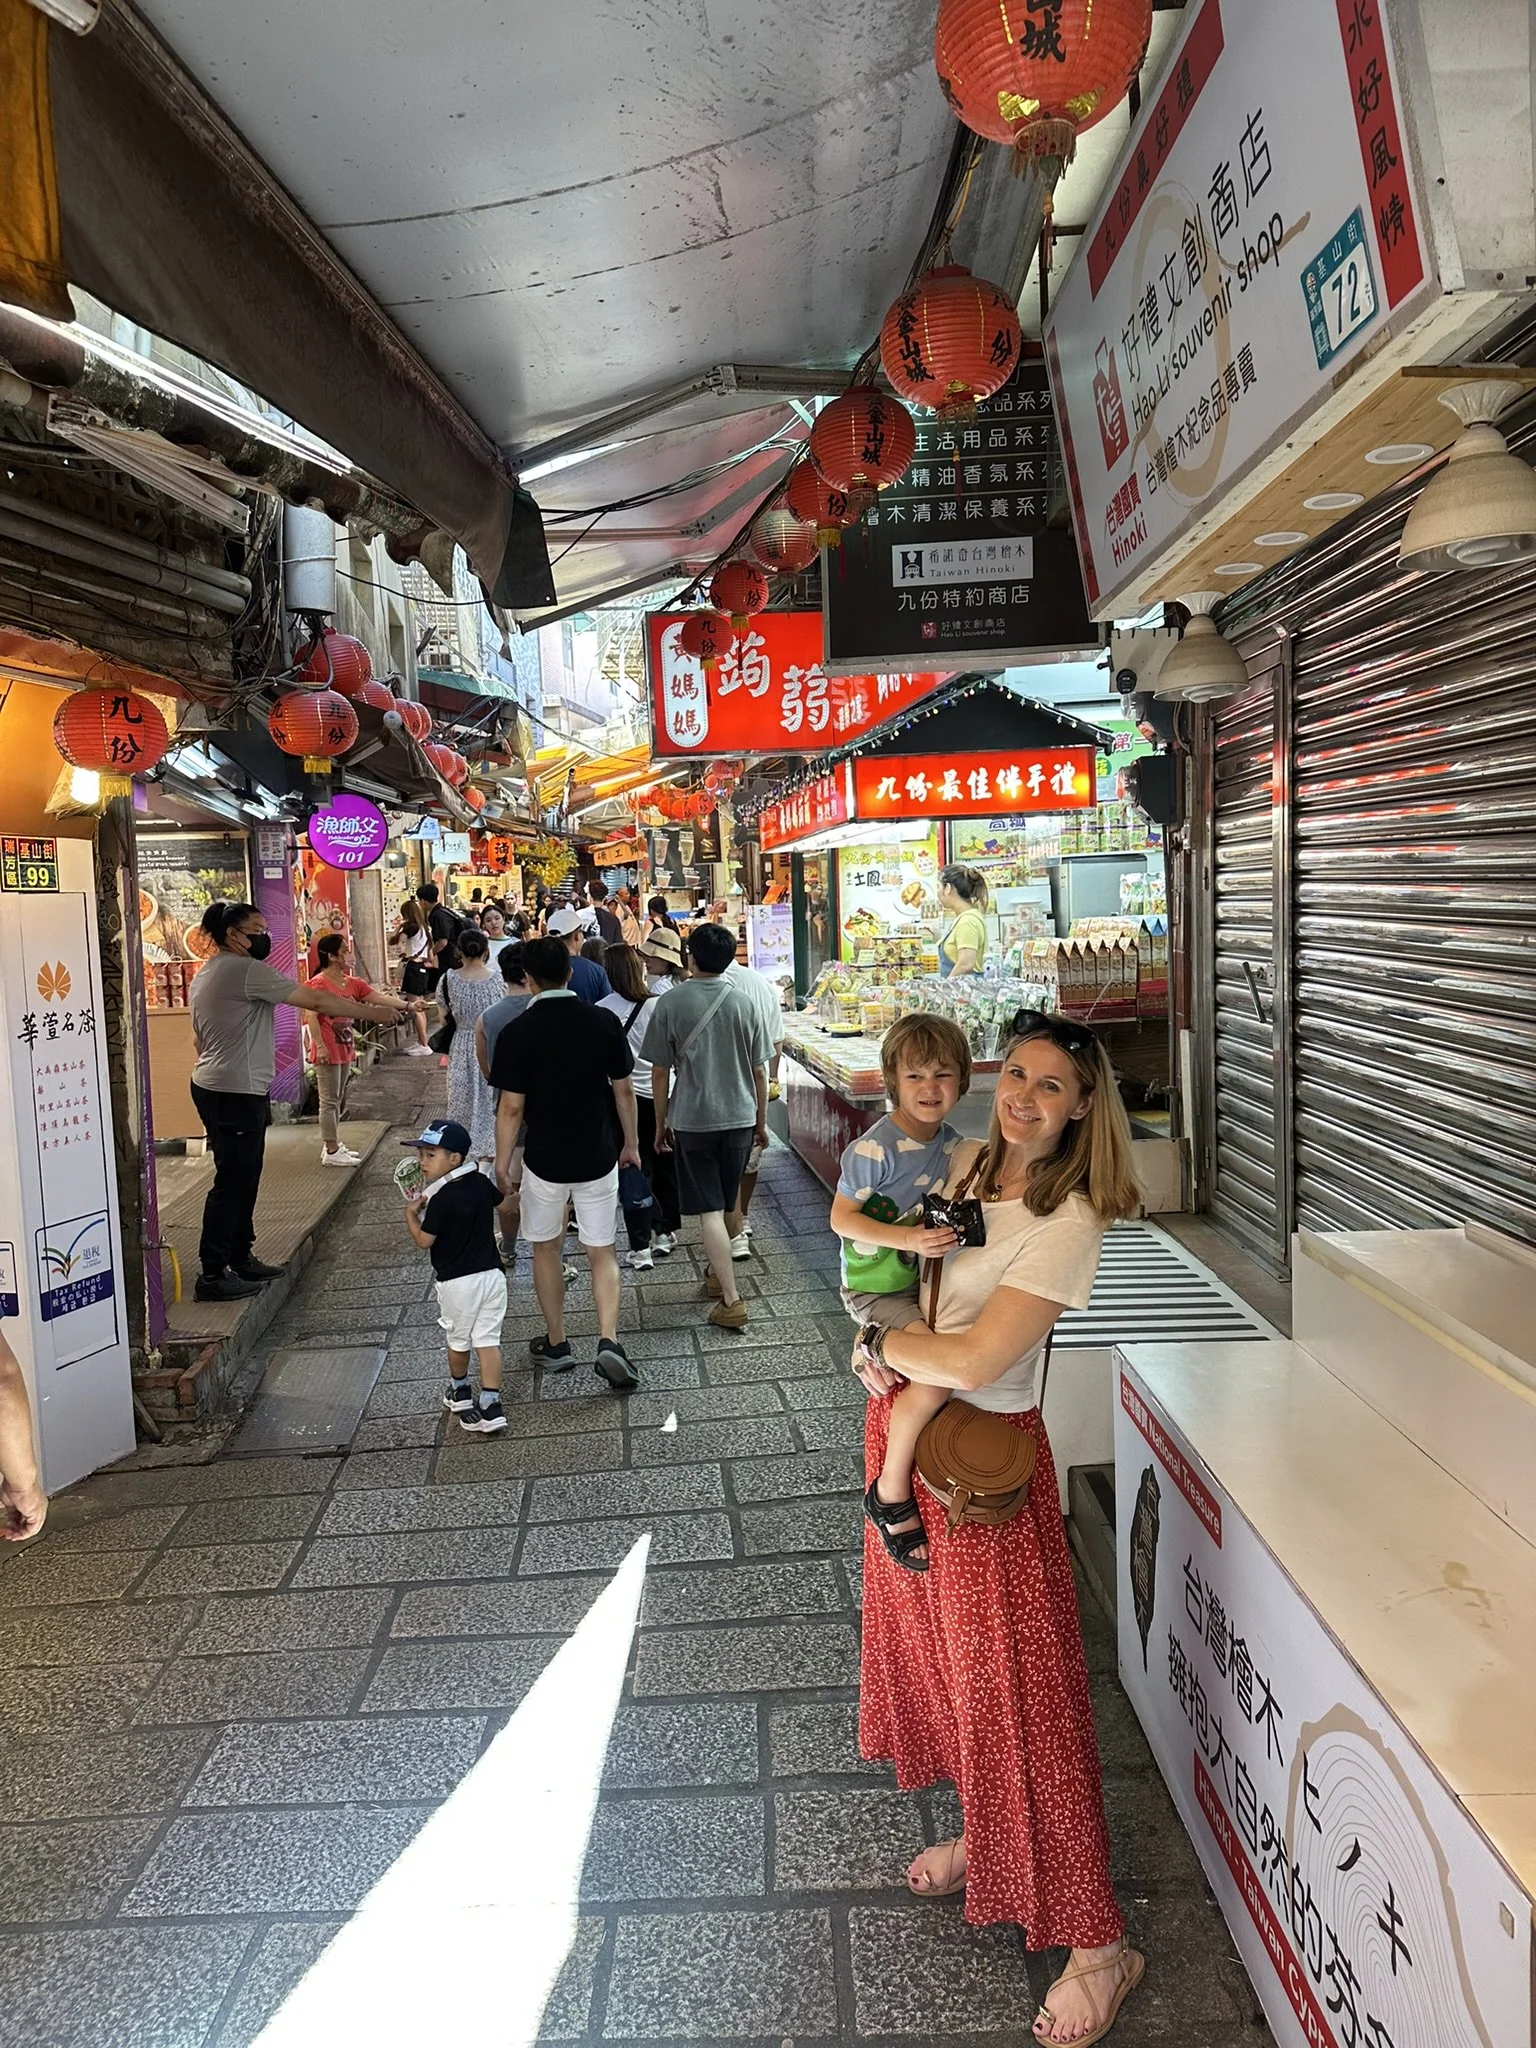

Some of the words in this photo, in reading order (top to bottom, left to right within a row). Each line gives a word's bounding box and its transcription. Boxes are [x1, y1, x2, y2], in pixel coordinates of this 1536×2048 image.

[1121, 107, 1273, 384] 好禮文創商店
[1131, 385, 1157, 432] Hao
[1155, 352, 1171, 399] Li
[1171, 274, 1232, 382] souvenir
[1237, 212, 1285, 293] shop
[1332, 260, 1361, 336] 72
[1144, 341, 1258, 496] 台灣檜木紀念品專賣
[1105, 471, 1142, 537] 台灣國寶
[930, 568, 970, 577] Taiwan
[975, 564, 1016, 575] Hinoki
[1111, 511, 1148, 568] Hinoki
[898, 585, 1030, 611] 九份特約商店
[700, 619, 717, 655] 九份
[716, 630, 830, 734] 蒟蒻
[109, 695, 144, 764] 九份
[875, 761, 1077, 802] 九份最佳伴手禮
[20, 841, 53, 860] 基山街
[316, 815, 380, 836] 漁師父
[337, 851, 365, 864] 101
[26, 866, 50, 887] 99
[54, 1287, 68, 1298] Tax
[72, 1275, 101, 1293] Refund
[1149, 1418, 1181, 1480] National
[1181, 1463, 1221, 1537] Treasure
[1183, 1553, 1284, 1768] 台灣檜木
[1167, 1623, 1396, 2048] 擁抱大自然的芬
[1198, 1769, 1233, 1855] Hinoki
[1241, 1865, 1286, 1971] Taiwan
